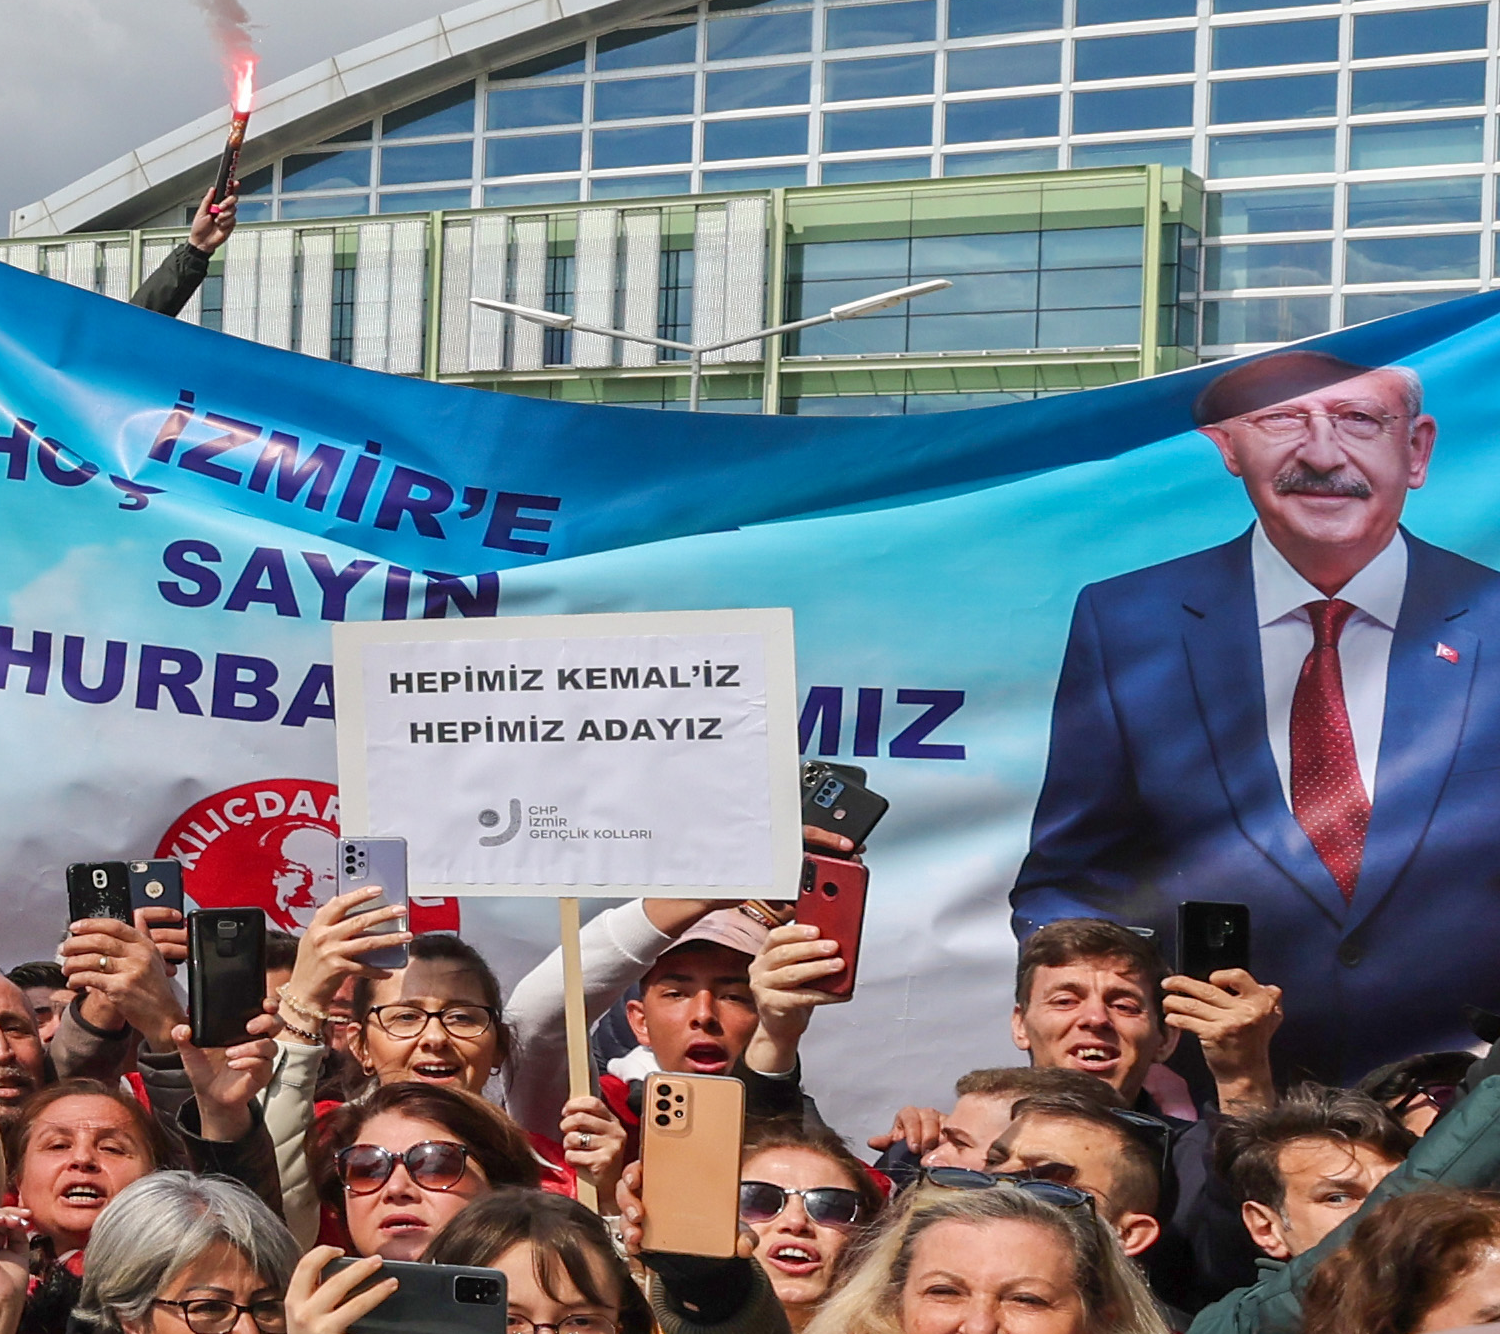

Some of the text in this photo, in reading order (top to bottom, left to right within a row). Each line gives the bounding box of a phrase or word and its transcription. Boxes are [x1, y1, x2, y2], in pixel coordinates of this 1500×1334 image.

[147, 388, 561, 556] İZMİR'E
[157, 540, 500, 622] SAYIN
[390, 662, 741, 694] HEPİMİZ KEMAL'İZ
[409, 714, 723, 744] HEPİMİZ ADAYIZ
[528, 805, 559, 816] CHP
[529, 827, 653, 842] GENÇLİK KOLLARI
